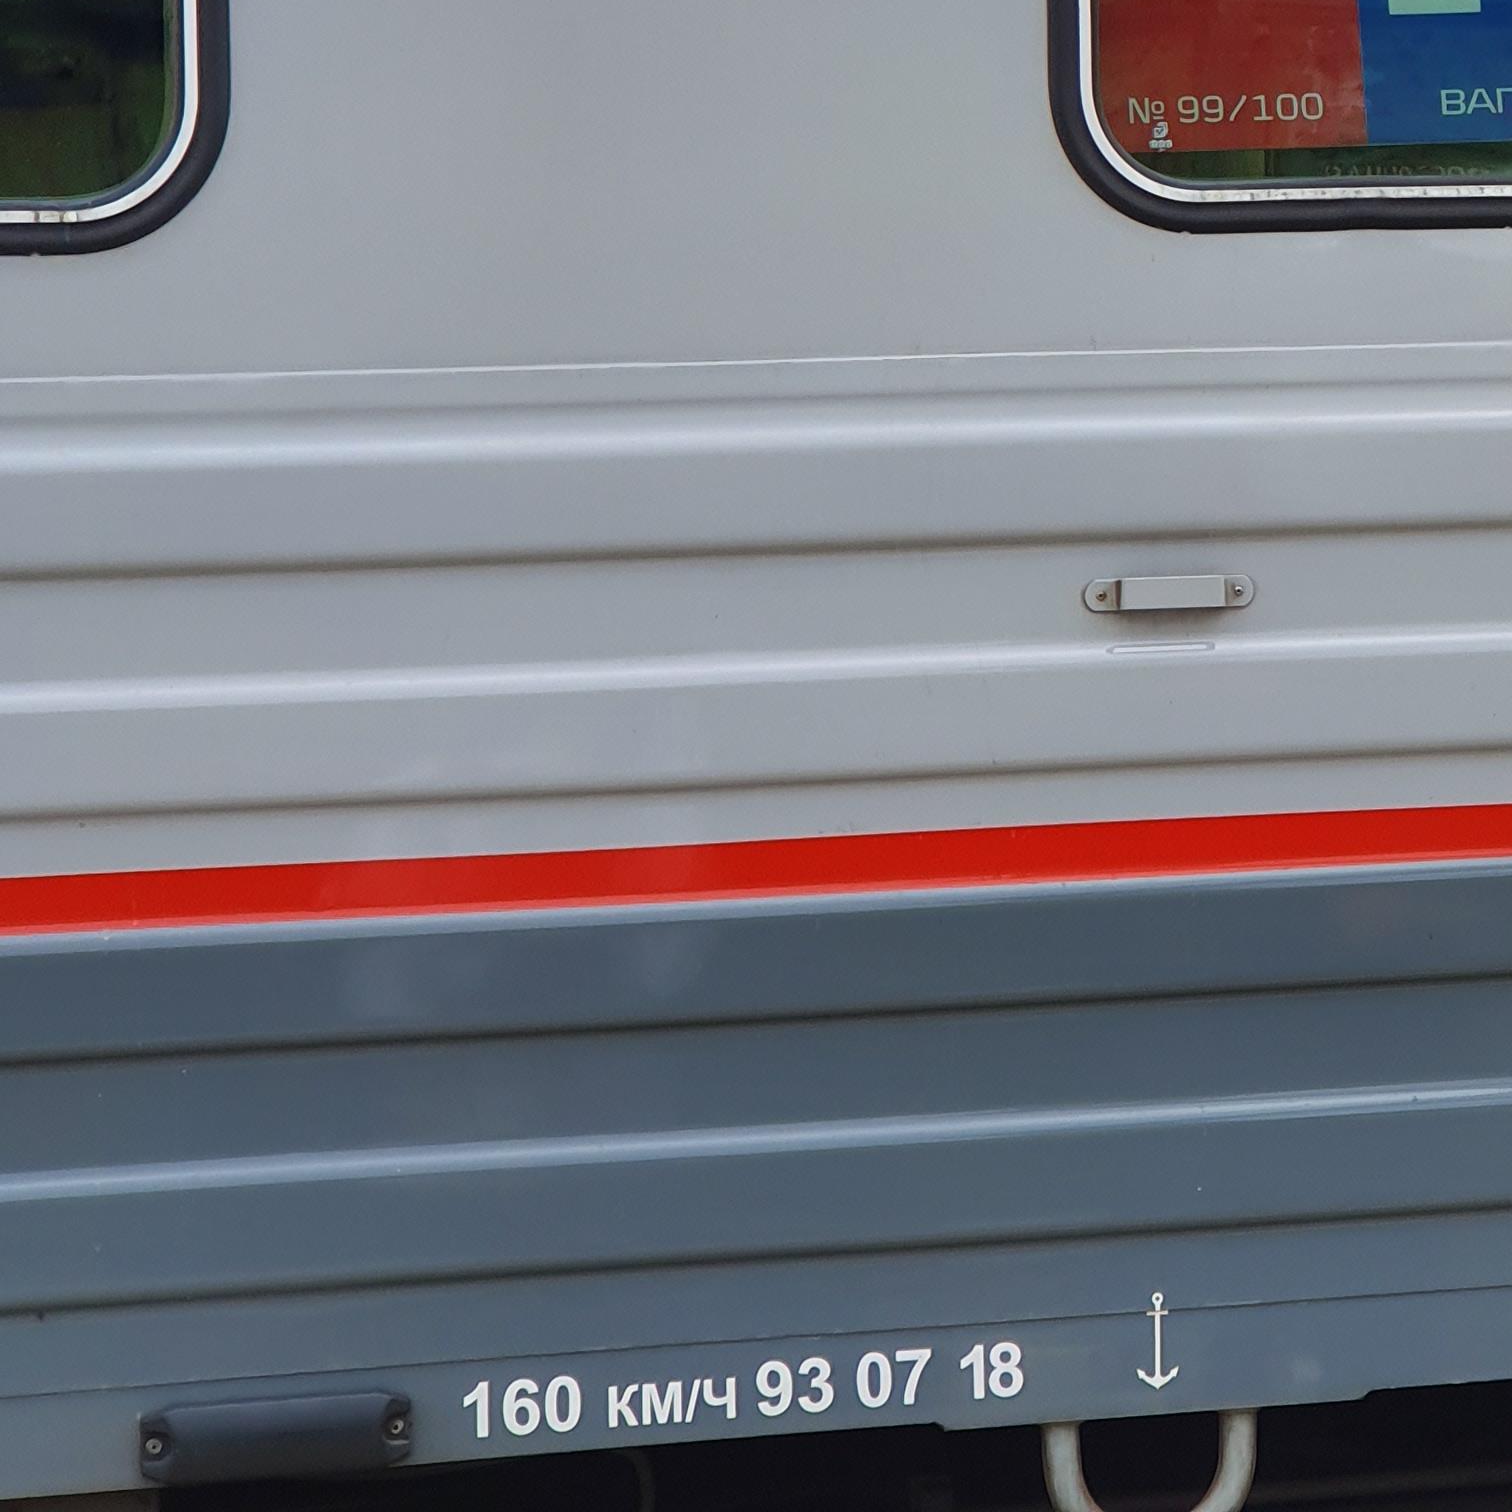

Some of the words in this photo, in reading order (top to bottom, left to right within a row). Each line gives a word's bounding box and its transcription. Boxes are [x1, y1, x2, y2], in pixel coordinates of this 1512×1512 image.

[1177, 91, 1325, 124] 99/100
[460, 1374, 583, 1439] 160
[755, 1356, 835, 1418] 93
[854, 1347, 933, 1409] 07
[958, 1341, 1025, 1400] 18
